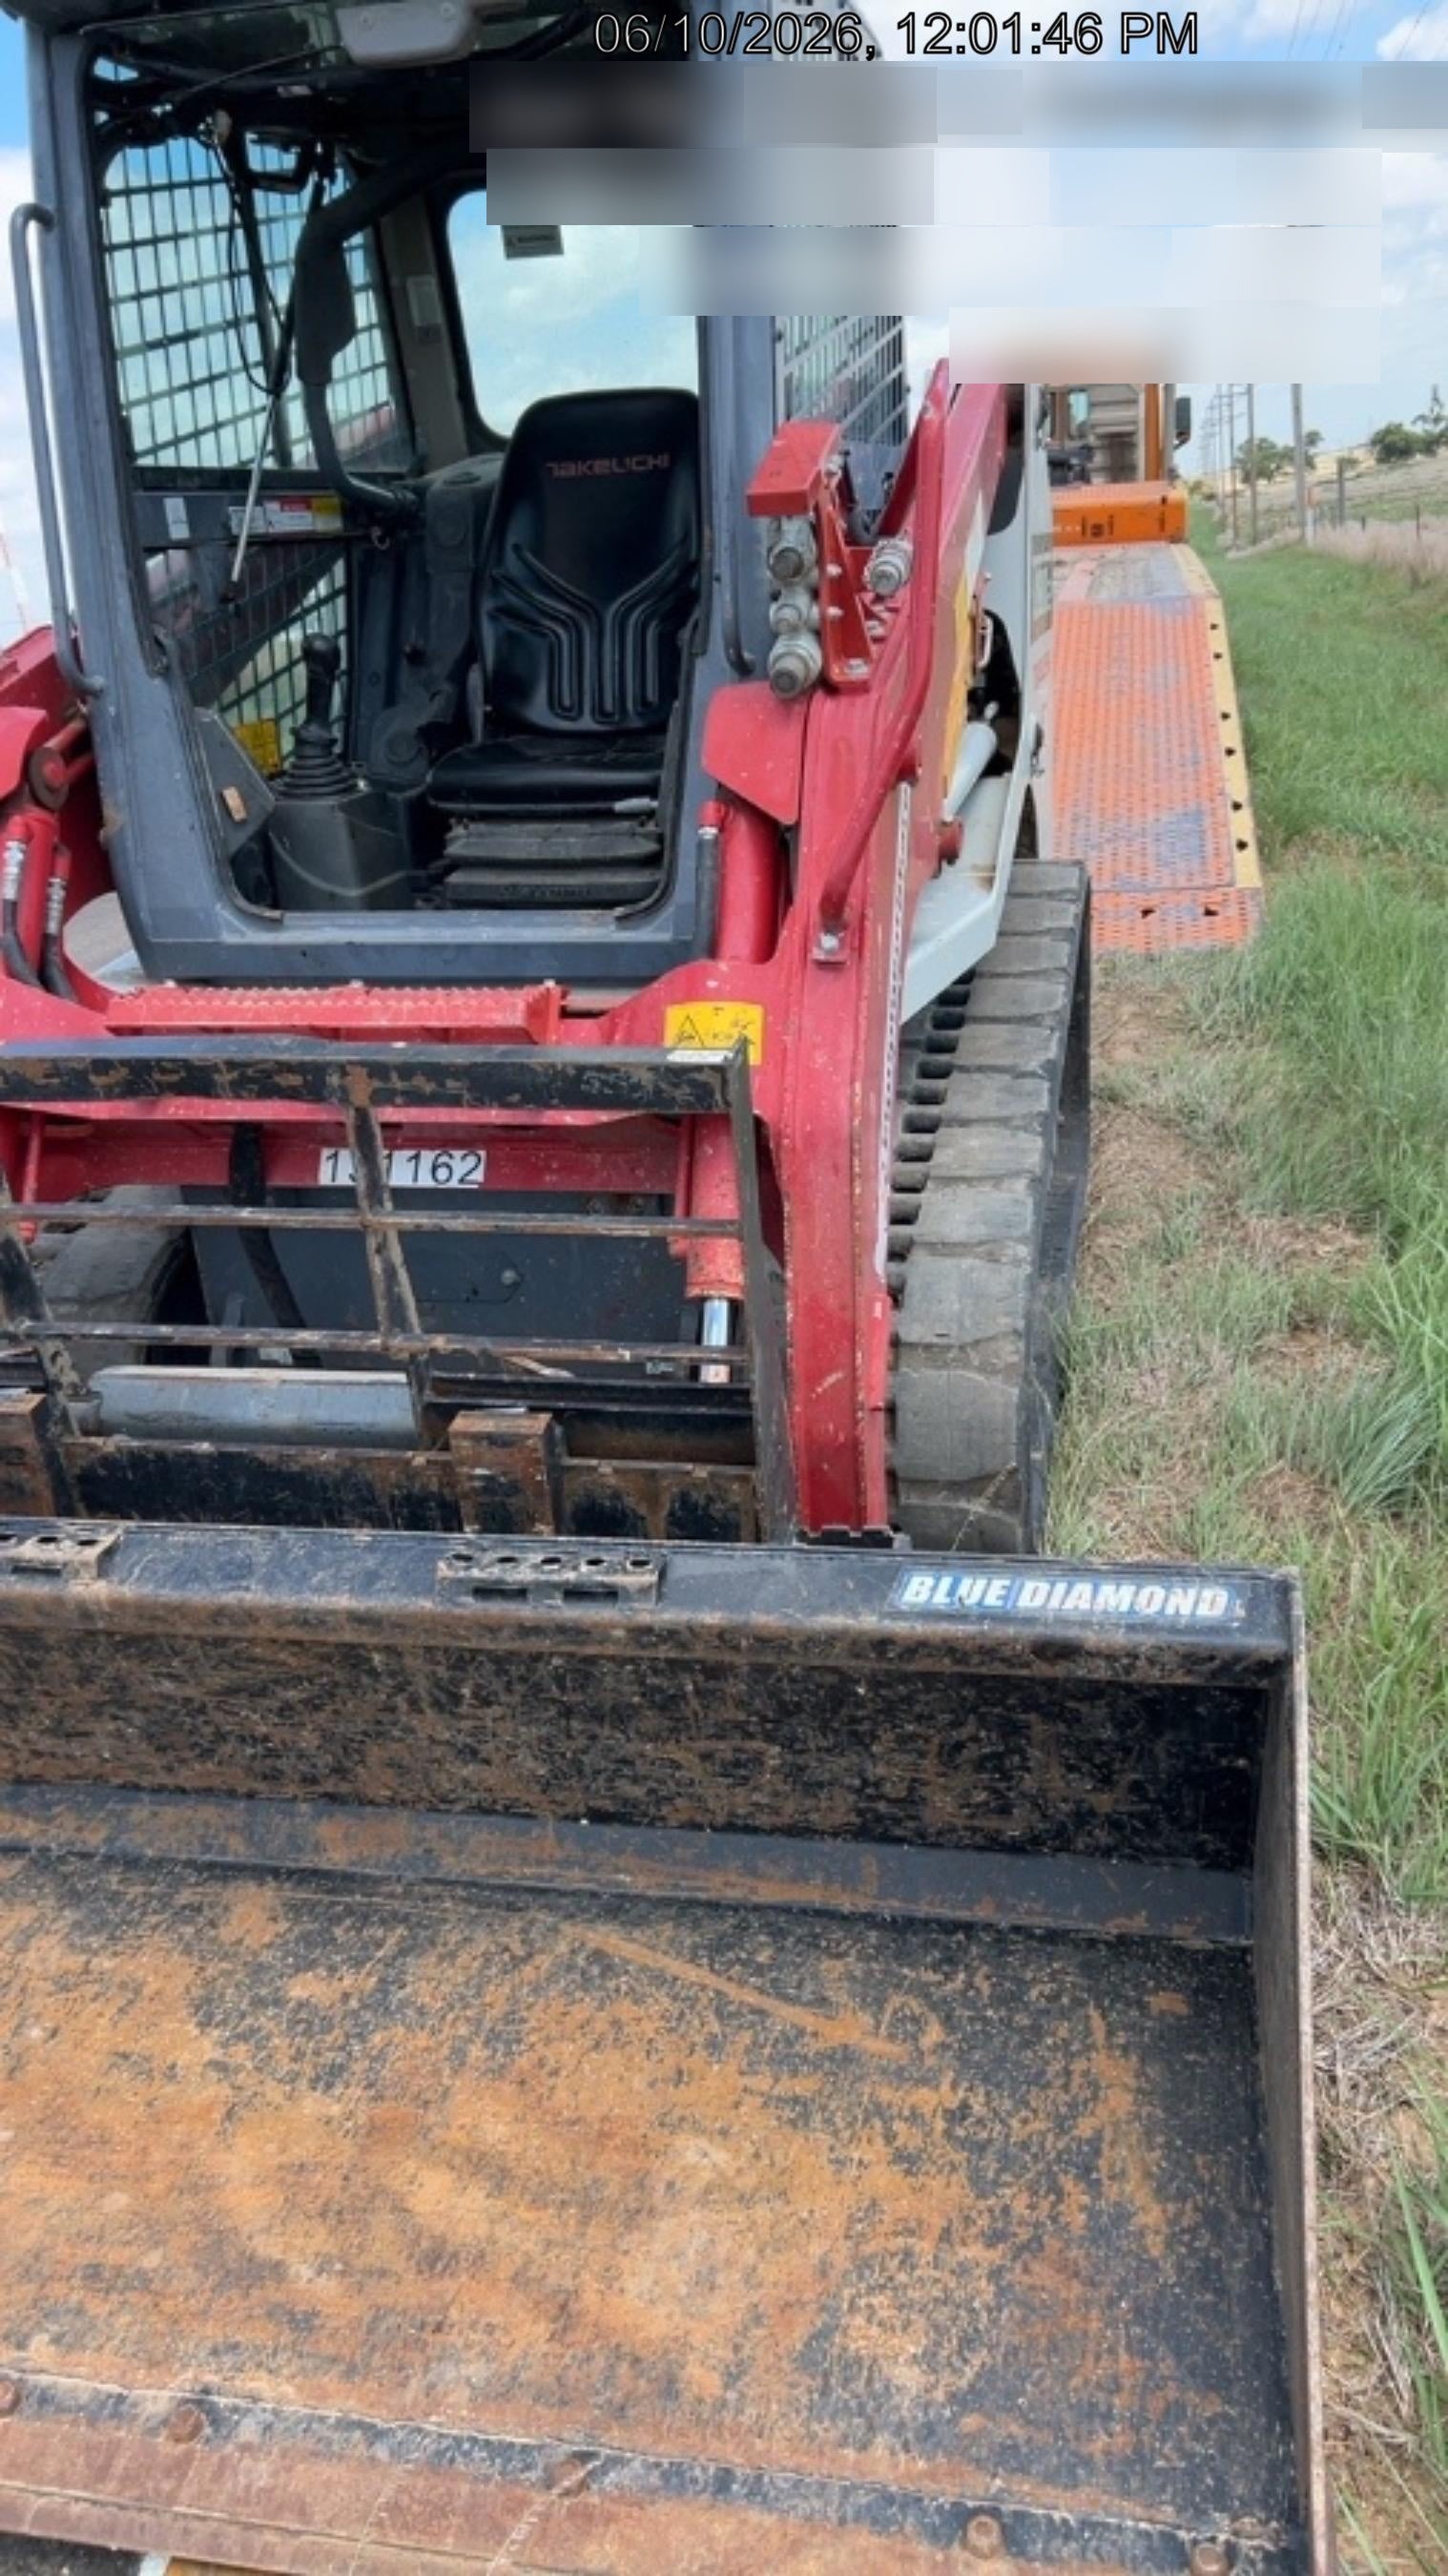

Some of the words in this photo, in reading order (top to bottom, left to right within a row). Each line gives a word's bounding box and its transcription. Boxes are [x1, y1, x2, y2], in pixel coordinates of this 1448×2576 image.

[545, 452, 671, 478] TAKEUCHI
[900, 1575, 1011, 1606] BLUE
[1016, 1579, 1229, 1616] DIAMOND
